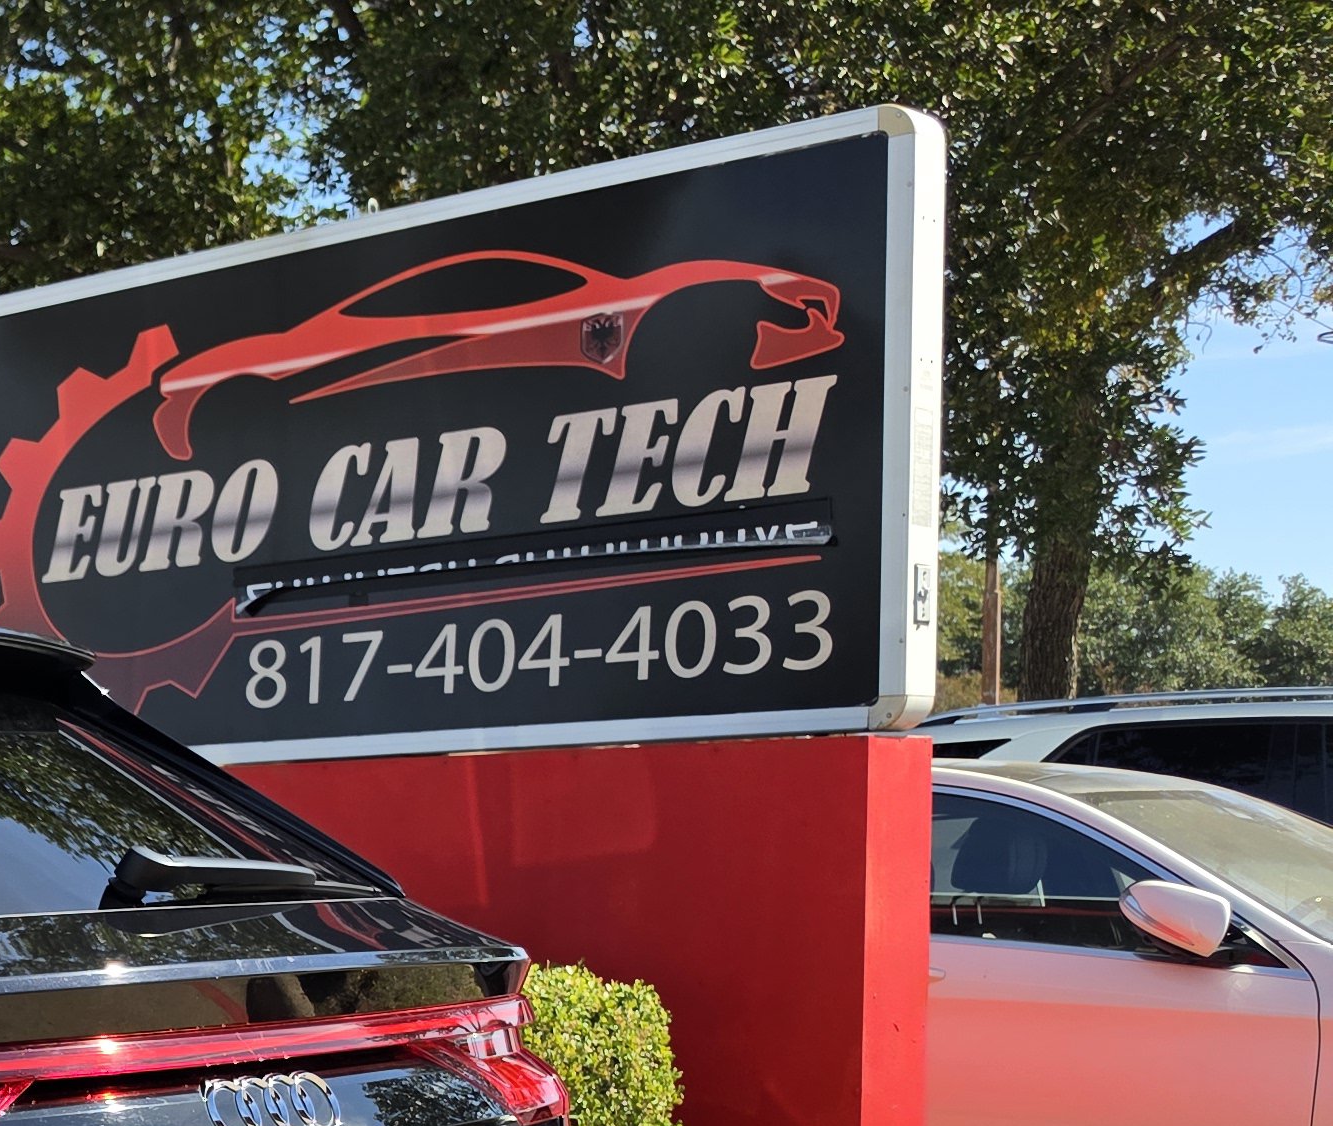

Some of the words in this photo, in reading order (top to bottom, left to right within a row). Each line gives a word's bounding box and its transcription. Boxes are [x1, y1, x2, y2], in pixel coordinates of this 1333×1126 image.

[41, 458, 277, 584] EURO
[309, 426, 507, 552] CAR
[540, 374, 837, 525] TECH
[245, 588, 833, 709] 817-404-4033
